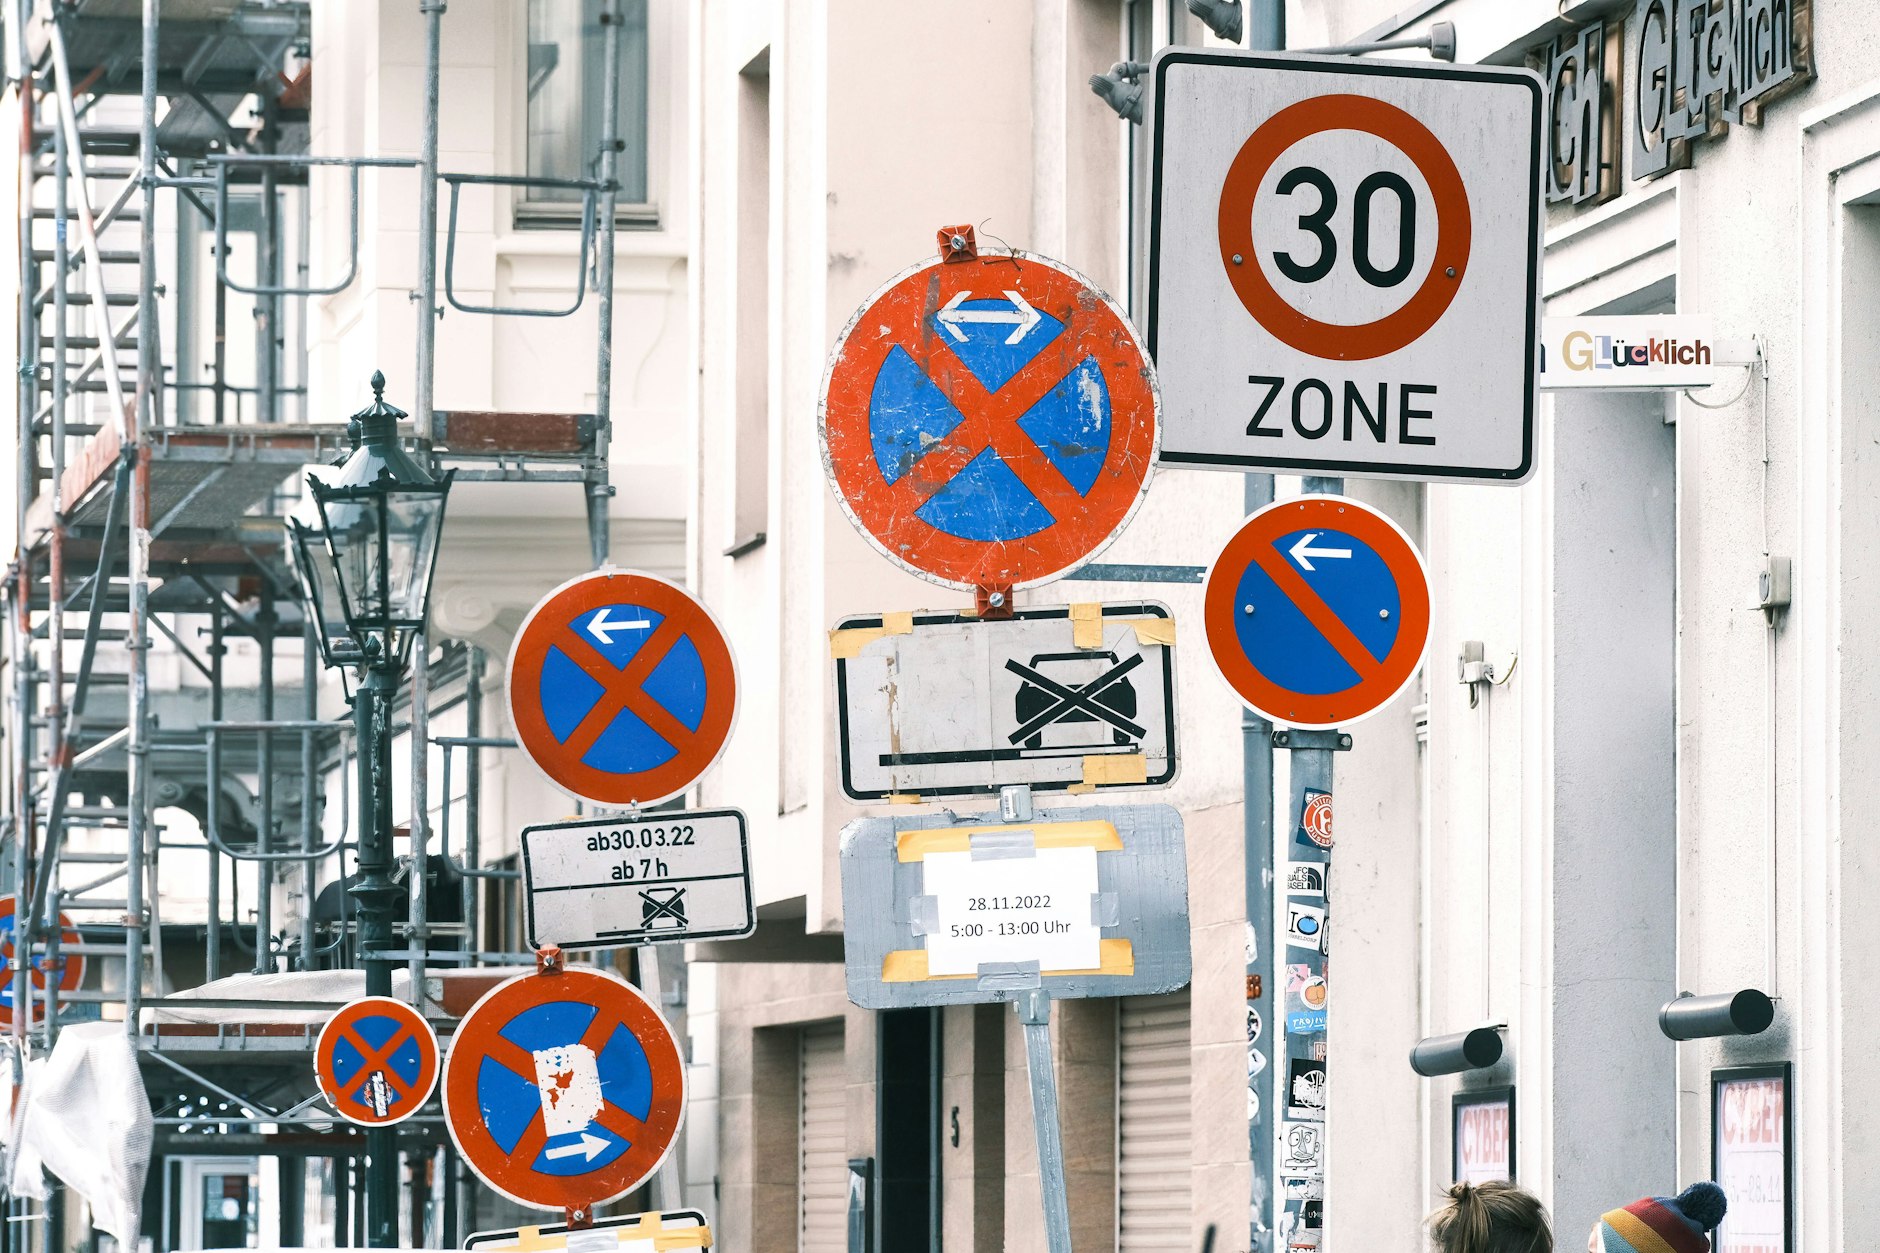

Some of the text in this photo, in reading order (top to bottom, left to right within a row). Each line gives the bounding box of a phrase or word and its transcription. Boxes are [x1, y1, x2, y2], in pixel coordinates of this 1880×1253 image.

[1272, 166, 1417, 288] 30
[1246, 375, 1437, 446] ZONE
[611, 858, 668, 880] ab 7 h
[968, 895, 1052, 911] 28.11.2022
[951, 923, 983, 937] 5:00
[998, 921, 1039, 936] 13:00
[1044, 920, 1071, 934] Uhr
[951, 1105, 960, 1148] 5
